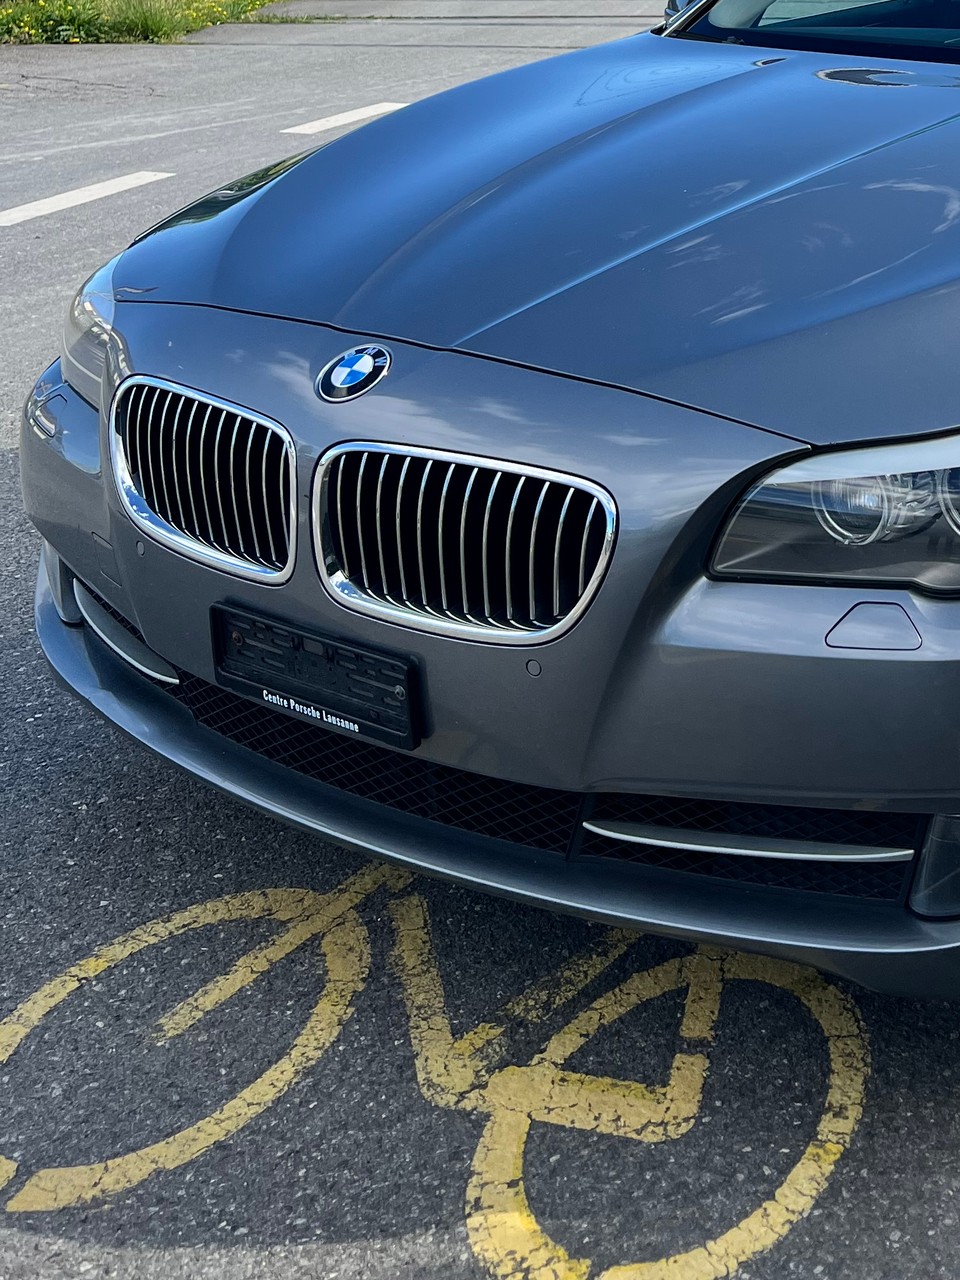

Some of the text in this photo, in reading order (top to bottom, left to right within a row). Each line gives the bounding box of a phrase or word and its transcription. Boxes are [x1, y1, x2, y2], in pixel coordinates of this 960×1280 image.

[263, 690, 359, 733] Centre Porsche Lausanne
